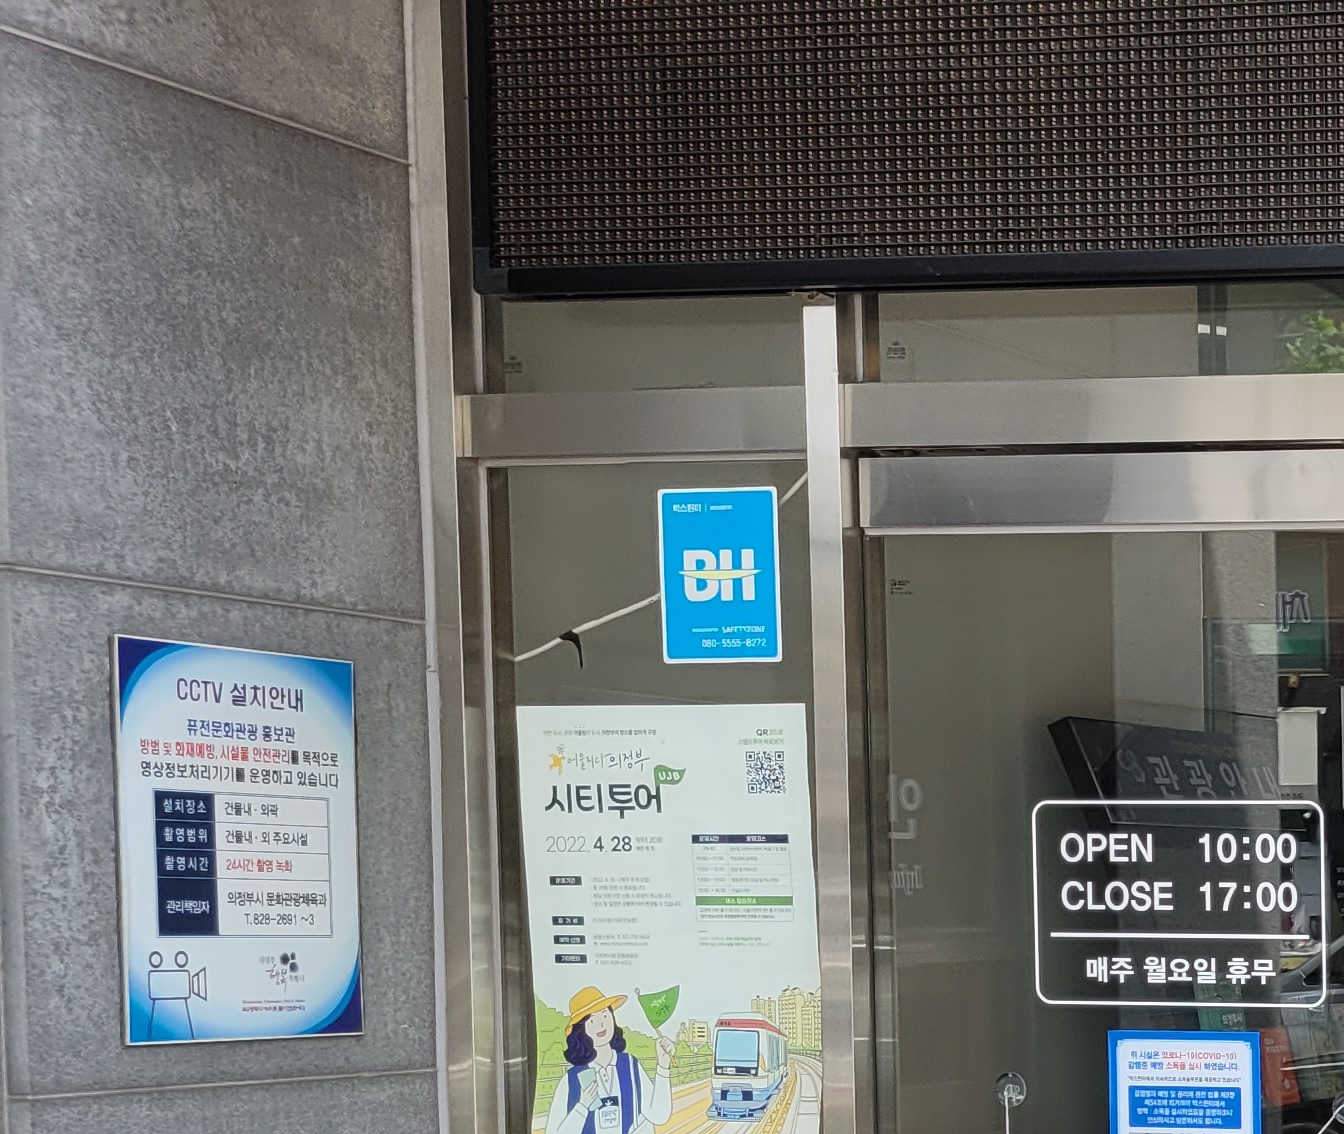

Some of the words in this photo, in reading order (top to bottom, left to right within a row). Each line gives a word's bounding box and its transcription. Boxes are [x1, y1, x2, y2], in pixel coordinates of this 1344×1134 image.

[683, 549, 756, 602] BH
[176, 677, 223, 704] CCTV
[229, 681, 304, 713] 설치안내
[186, 718, 258, 743] 퓨전문화관광
[261, 723, 296, 745] 홍보관
[220, 743, 250, 763] 시설물
[301, 748, 339, 767] 목적으로
[249, 767, 294, 786] 운영하고
[296, 770, 340, 789] 있습니다
[658, 771, 681, 782] UJB
[163, 797, 207, 815] 설치장소
[224, 801, 252, 817] 건물내
[545, 783, 662, 819] 시티투어
[163, 826, 208, 844] 촬영범위
[272, 831, 309, 848] 주요시설
[1060, 833, 1153, 863] OPEN
[1198, 833, 1297, 864] 10:00
[164, 855, 209, 872] 촬영시간
[227, 891, 264, 908] 의정부시
[1061, 881, 1174, 911] CLOSE
[1199, 881, 1298, 912] 17:00
[1086, 956, 1134, 983] 매주
[1143, 956, 1217, 984] 월요일
[1225, 957, 1276, 985] 휴무
